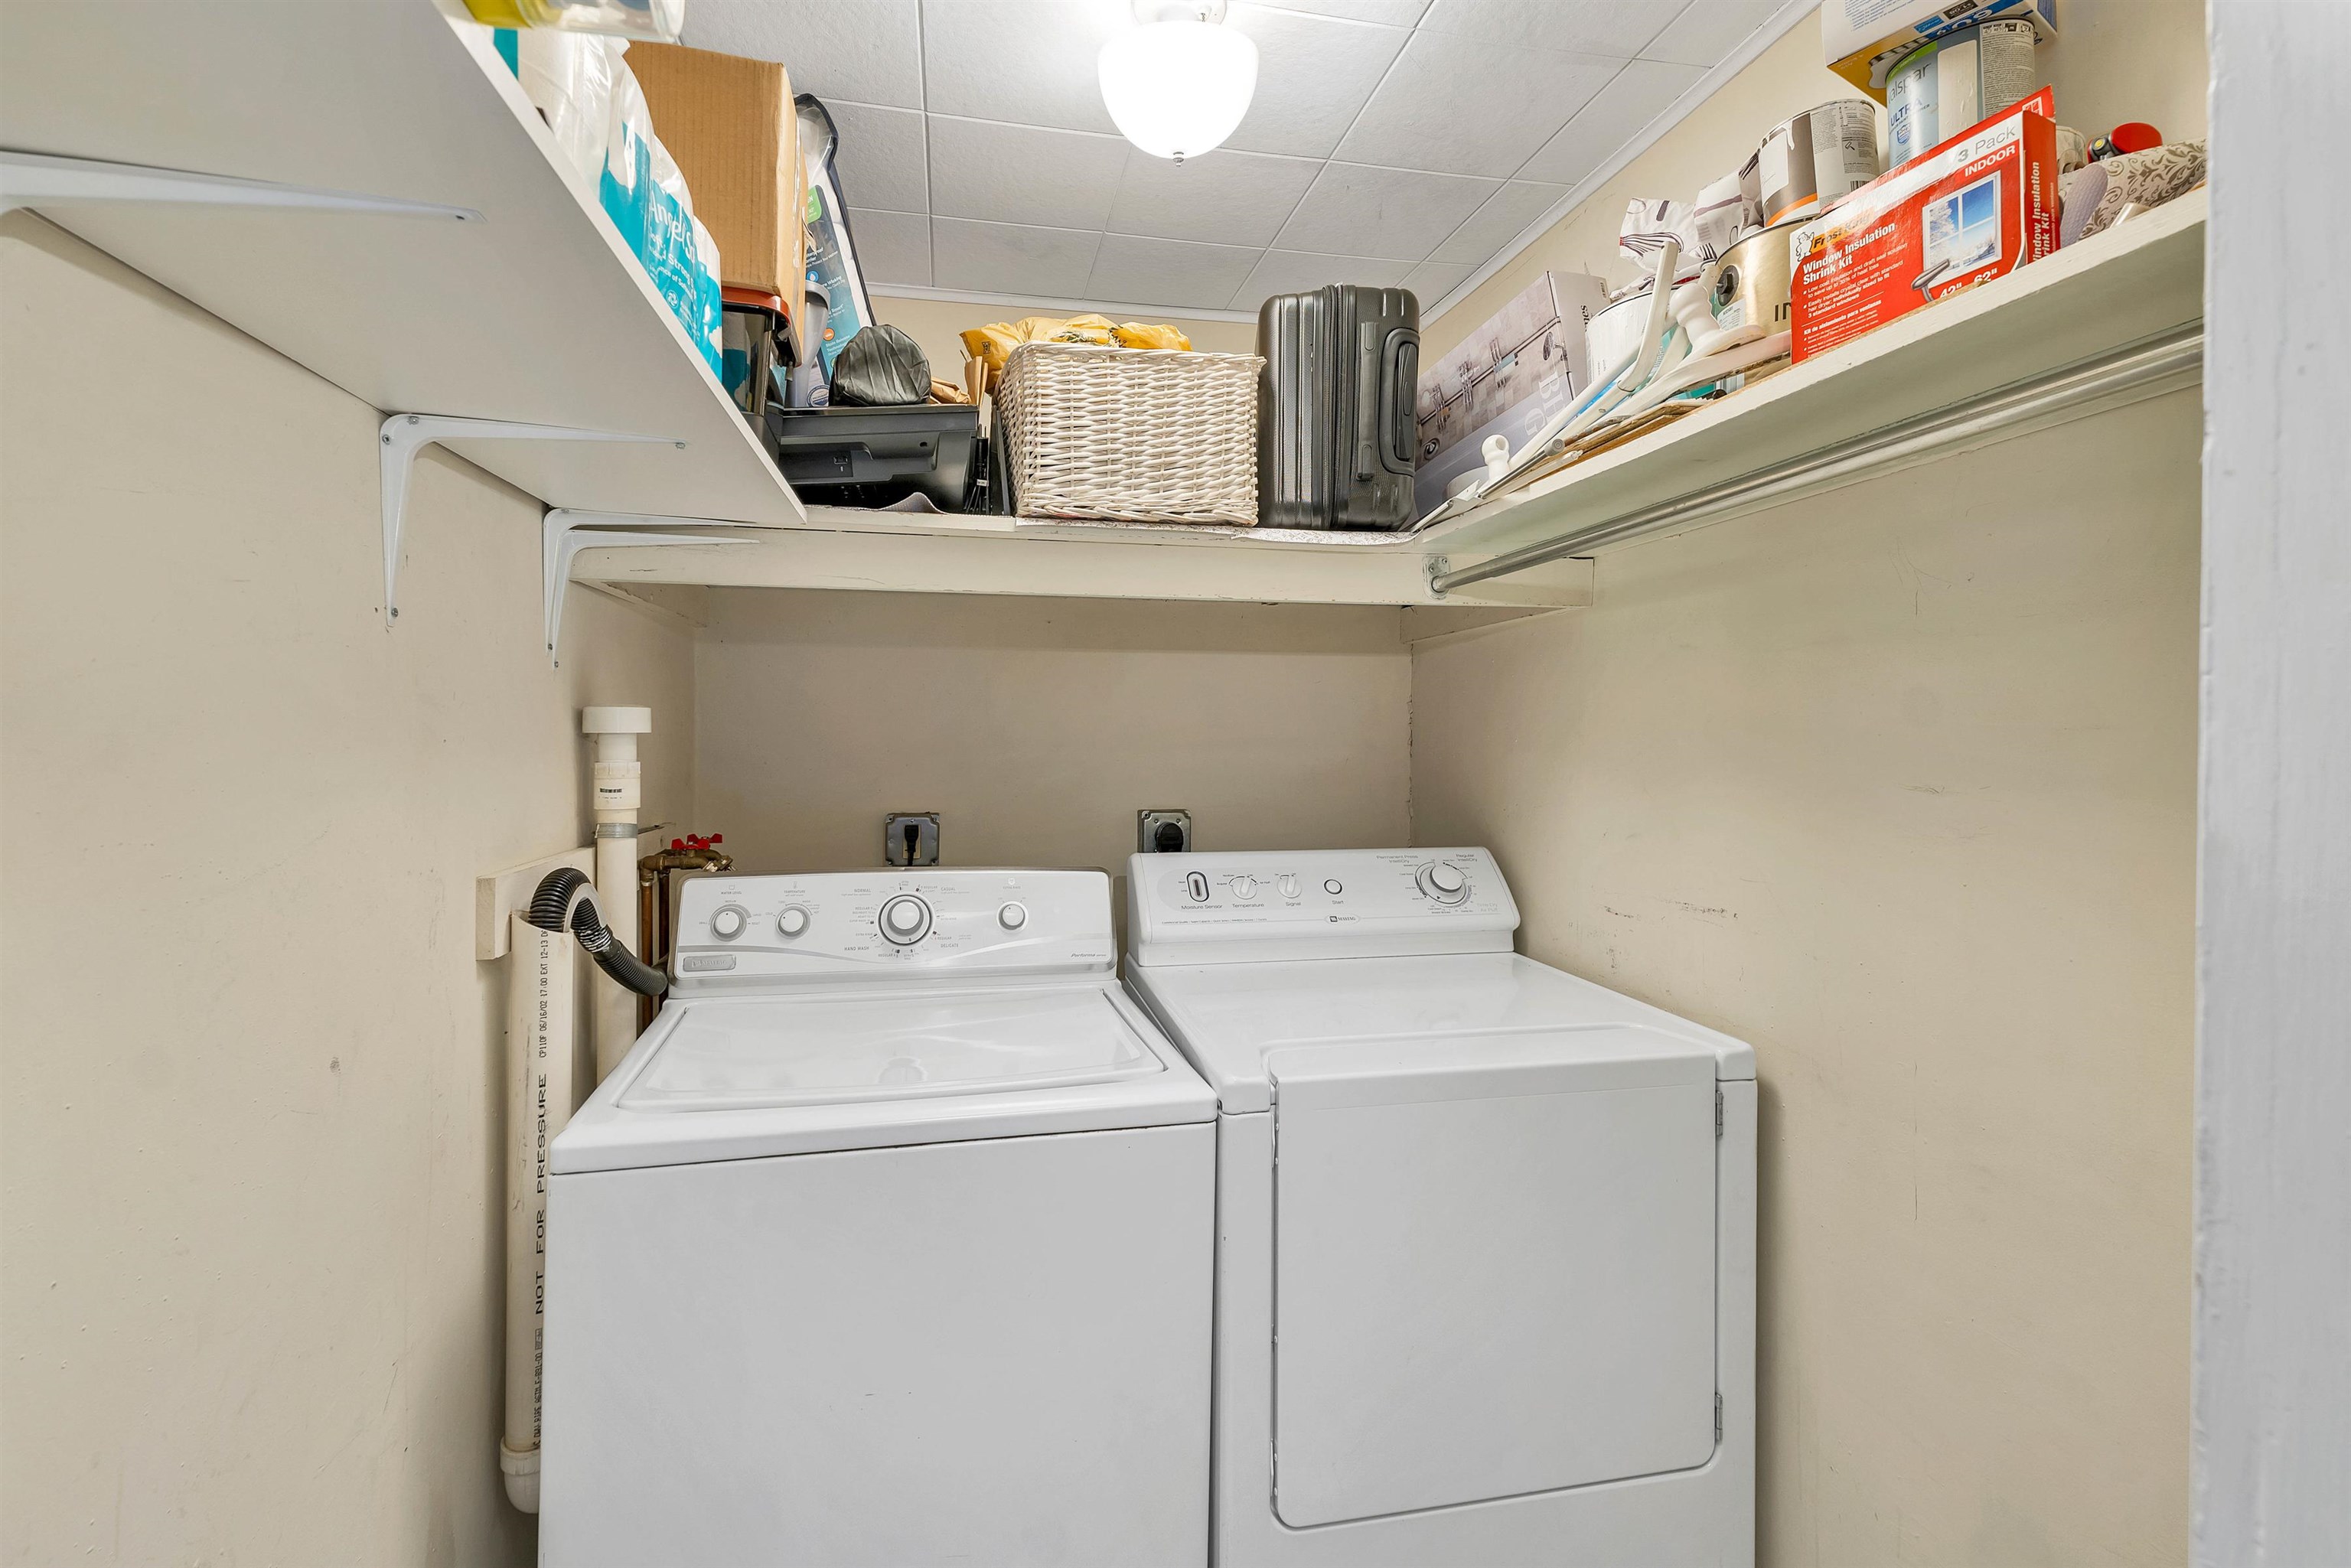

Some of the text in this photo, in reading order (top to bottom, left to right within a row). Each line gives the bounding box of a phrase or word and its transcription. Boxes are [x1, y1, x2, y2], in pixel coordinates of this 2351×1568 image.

[1958, 125, 2016, 163] 3 Pack
[1965, 145, 2016, 177] INDOOR
[2031, 161, 2041, 219] Insulation
[1803, 222, 1896, 275] Window Insulation
[2042, 213, 2050, 256] rink Kit
[1803, 253, 1853, 285] Shrink Kit
[1808, 285, 1818, 293] Low
[1819, 279, 1829, 288] cost
[1854, 263, 1862, 272] and
[1864, 257, 1874, 267] draft
[1877, 251, 1886, 261] seal
[1808, 297, 1821, 308] Easily
[1870, 269, 1880, 279] with
[1881, 259, 1903, 274] standard
[1814, 287, 1824, 296] save
[1857, 266, 1867, 275] heat
[1869, 262, 1879, 271] loss
[1863, 278, 1876, 288] sized
[1813, 302, 1834, 316] standard
[1837, 292, 1859, 306] windows
[540, 940, 549, 959] 12-13
[540, 963, 548, 975] EXT
[539, 1000, 547, 1031] 06/16/02
[535, 1073, 546, 1315] NOT FOR PRESSURE
